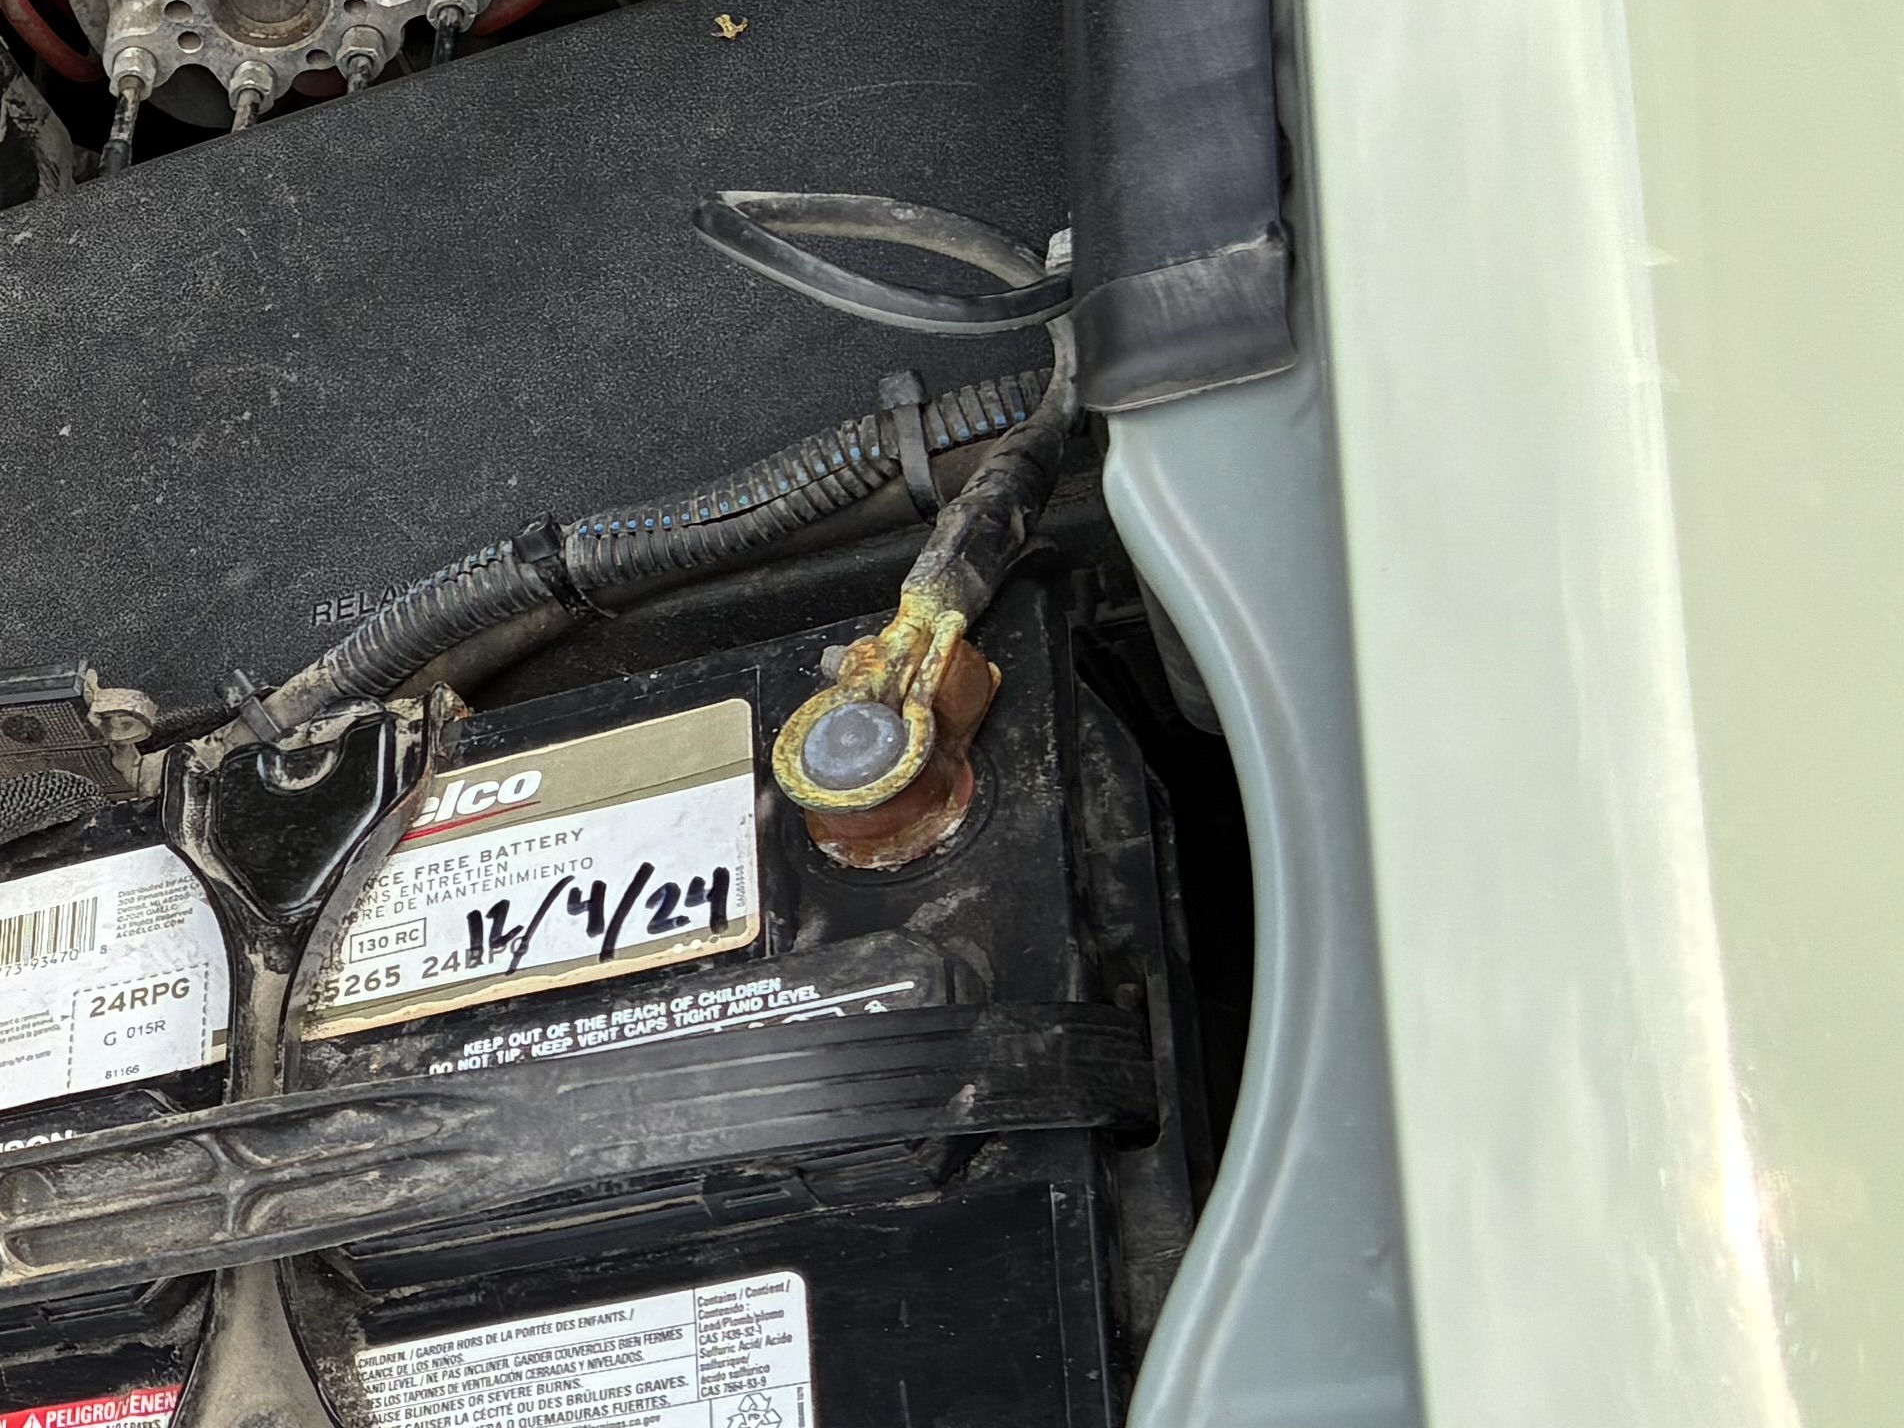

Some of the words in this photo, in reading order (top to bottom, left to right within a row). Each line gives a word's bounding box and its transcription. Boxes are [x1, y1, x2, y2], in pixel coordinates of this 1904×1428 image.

[310, 587, 406, 627] RELA
[414, 855, 469, 880] FREE
[480, 828, 584, 863] BATTERY
[394, 898, 415, 914] DE
[426, 856, 594, 906] MANTENIMIENTO
[400, 861, 508, 899] ENTRETIEN
[466, 861, 730, 975] 12/4/24
[358, 936, 388, 954] 130
[395, 928, 419, 944] RC
[89, 978, 191, 1018] 24RPG
[463, 1037, 504, 1057] KEEP
[508, 1027, 542, 1048] OUT
[546, 1022, 571, 1040] OF
[574, 1016, 608, 1035] THE
[611, 1003, 666, 1026] REACH
[670, 995, 694, 1013] OF
[697, 978, 782, 1008] CHILDREN
[103, 1032, 117, 1046] G
[126, 1020, 167, 1039] 015R
[456, 1054, 492, 1071] NOT
[531, 1037, 572, 1058] KEEP
[576, 1029, 618, 1048] VENT
[623, 1018, 669, 1041] CAPS
[672, 1005, 723, 1028] TIGHT
[726, 998, 764, 1019] AND
[767, 984, 821, 1009] LEVEL
[415, 1341, 454, 1358] GARDER
[456, 1336, 483, 1351] HORS
[485, 1333, 497, 1345] DE
[500, 1330, 512, 1342] LA
[555, 1318, 575, 1332] DES
[698, 1332, 718, 1345] CAS
[404, 1398, 465, 1419] BLINDNES
[467, 1394, 484, 1407] OR
[487, 1385, 533, 1403] SEVERE
[536, 1377, 583, 1395] BURNS.
[454, 1411, 469, 1425] LA
[516, 1400, 534, 1414] OU
[537, 1396, 562, 1410] DES
[635, 1374, 689, 1394] GRAVES.
[701, 1384, 721, 1397] CAS
[518, 1403, 609, 1428] QUEMADURAS
